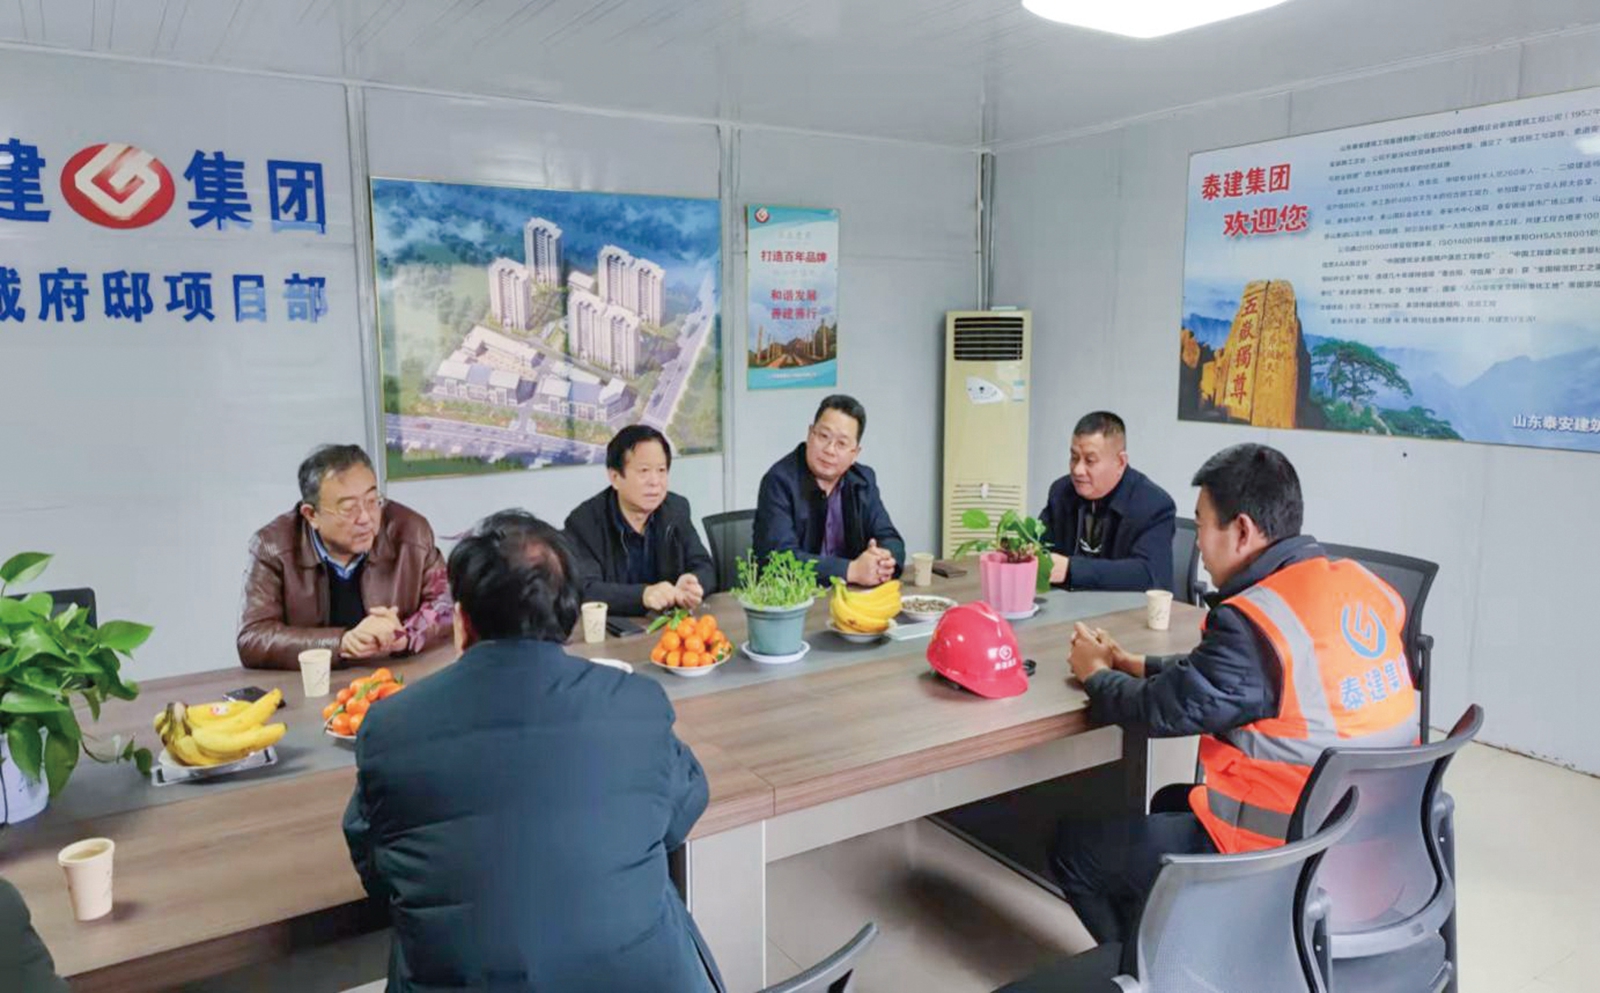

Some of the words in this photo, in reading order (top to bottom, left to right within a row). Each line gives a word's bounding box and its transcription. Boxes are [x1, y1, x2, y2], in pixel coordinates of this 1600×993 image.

[183, 149, 326, 234] 集团
[1201, 163, 1291, 200] 泰建集团
[1223, 204, 1308, 236] 欢迎您
[761, 250, 828, 264] 打造百年品牌
[771, 289, 817, 301] 和谐发展
